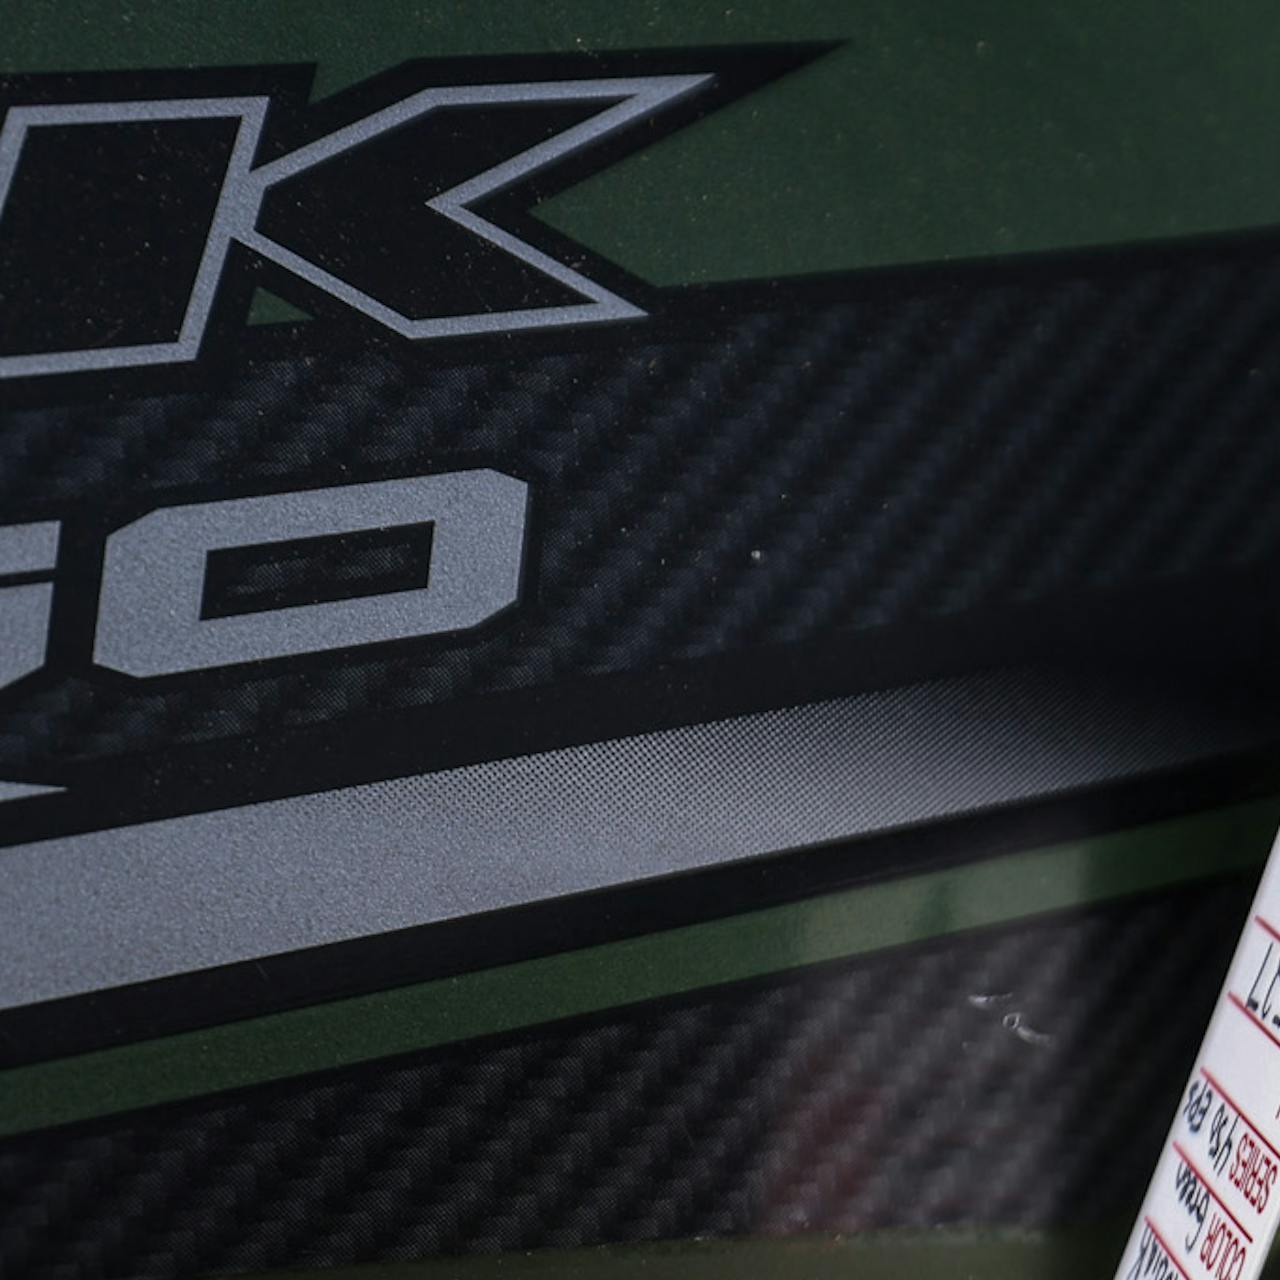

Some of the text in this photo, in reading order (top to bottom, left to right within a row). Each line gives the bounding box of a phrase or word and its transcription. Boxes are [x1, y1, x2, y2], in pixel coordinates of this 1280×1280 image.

[0, 467, 528, 691] 0
[1208, 1103, 1239, 1176] 450
[1228, 1132, 1278, 1216] SERIES
[1176, 1163, 1210, 1253] Green
